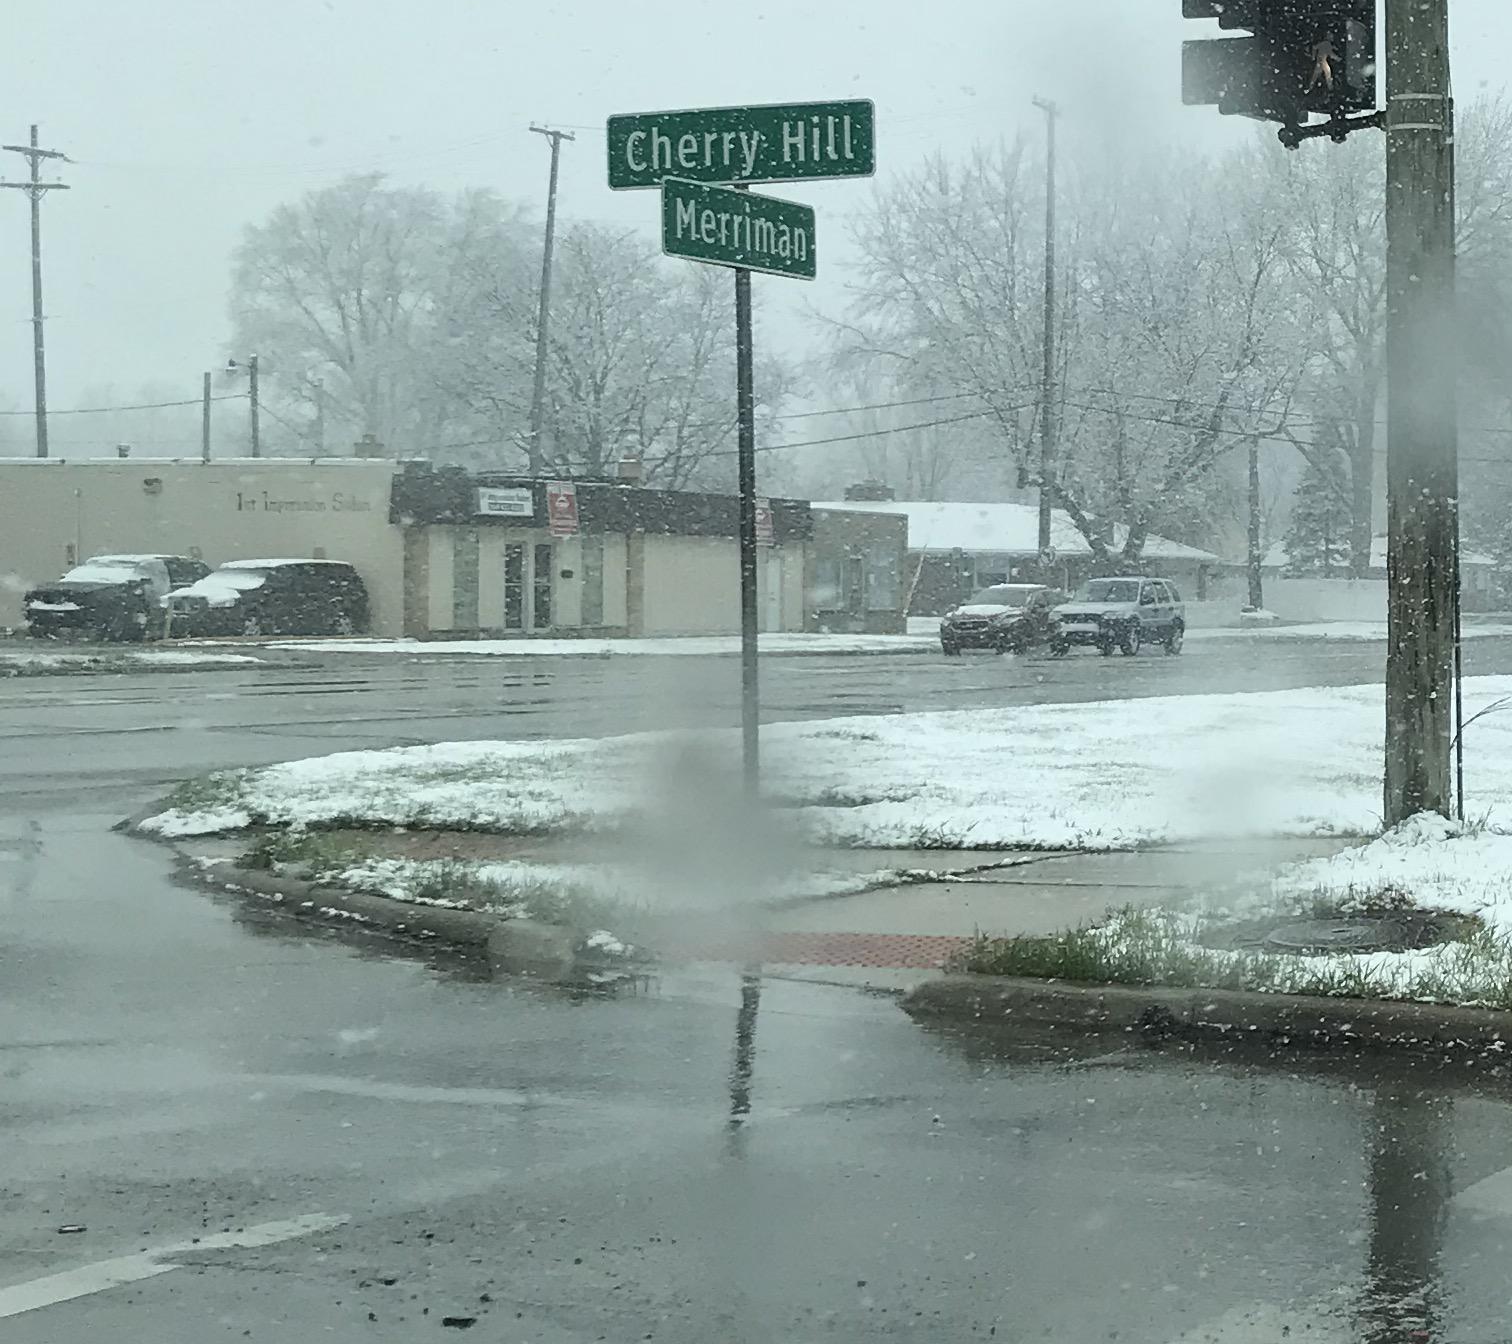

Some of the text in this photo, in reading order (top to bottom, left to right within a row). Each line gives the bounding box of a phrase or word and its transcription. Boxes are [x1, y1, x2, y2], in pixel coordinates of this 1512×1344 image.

[626, 115, 855, 176] Cherry Hill
[675, 197, 807, 262] Merriman
